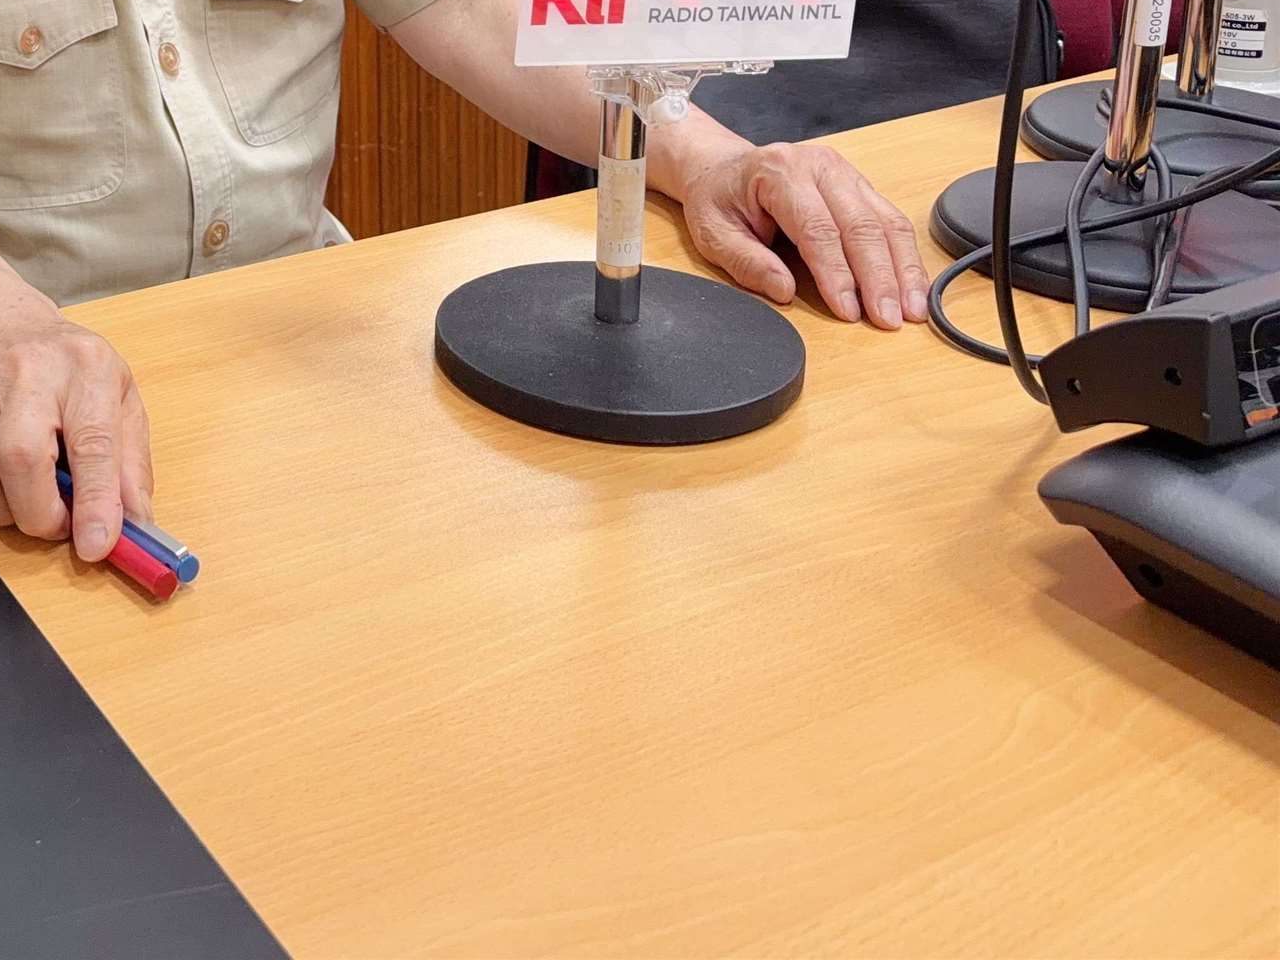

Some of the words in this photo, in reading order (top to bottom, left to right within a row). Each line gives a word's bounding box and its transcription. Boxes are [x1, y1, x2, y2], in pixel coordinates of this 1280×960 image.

[648, 6, 714, 24] RADIO
[717, 5, 794, 23] TAIWAN
[800, 3, 842, 21] INTL
